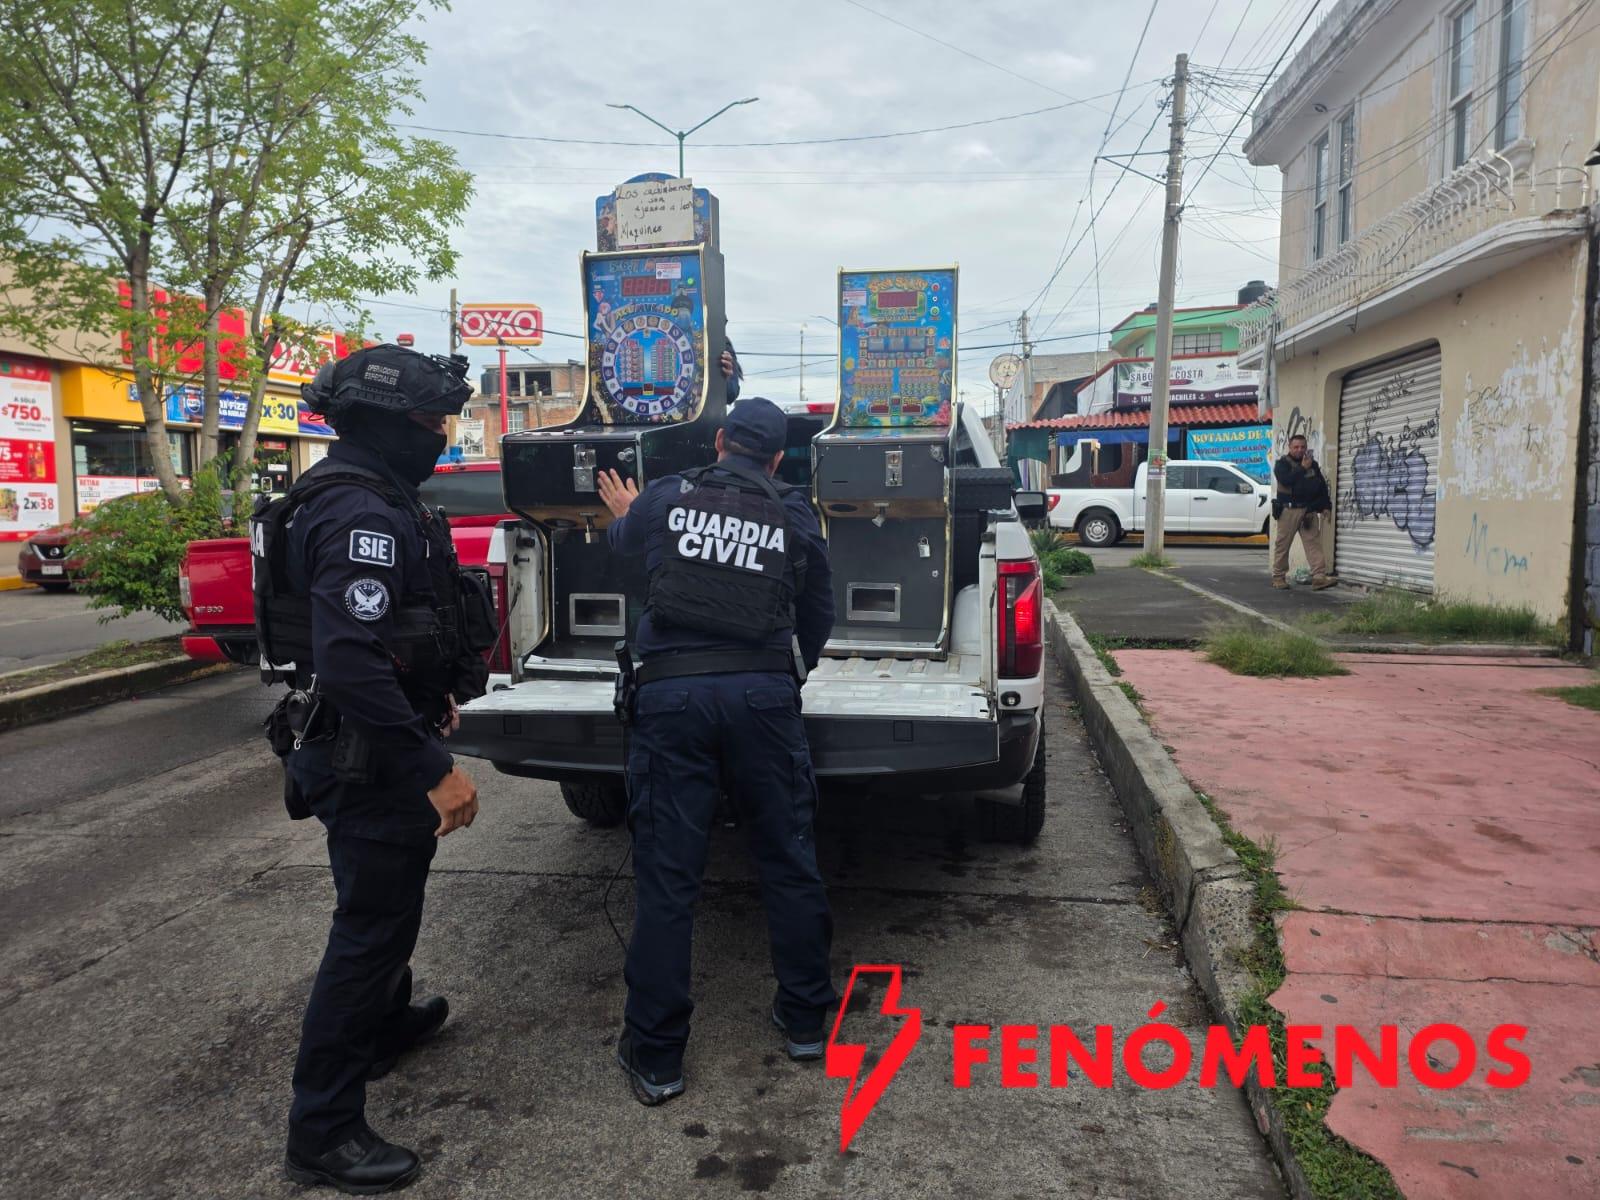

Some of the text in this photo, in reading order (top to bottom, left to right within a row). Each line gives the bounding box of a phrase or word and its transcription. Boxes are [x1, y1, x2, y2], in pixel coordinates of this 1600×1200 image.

[462, 308, 538, 337] OXXO
[1130, 369, 1203, 381] SABO COSTA
[2, 403, 42, 421] $750
[1193, 431, 1246, 443] BOTANAS
[1248, 430, 1262, 439] DE
[668, 507, 785, 552] GUARDIA
[358, 536, 389, 560] SIE
[678, 533, 764, 571] CIVIL
